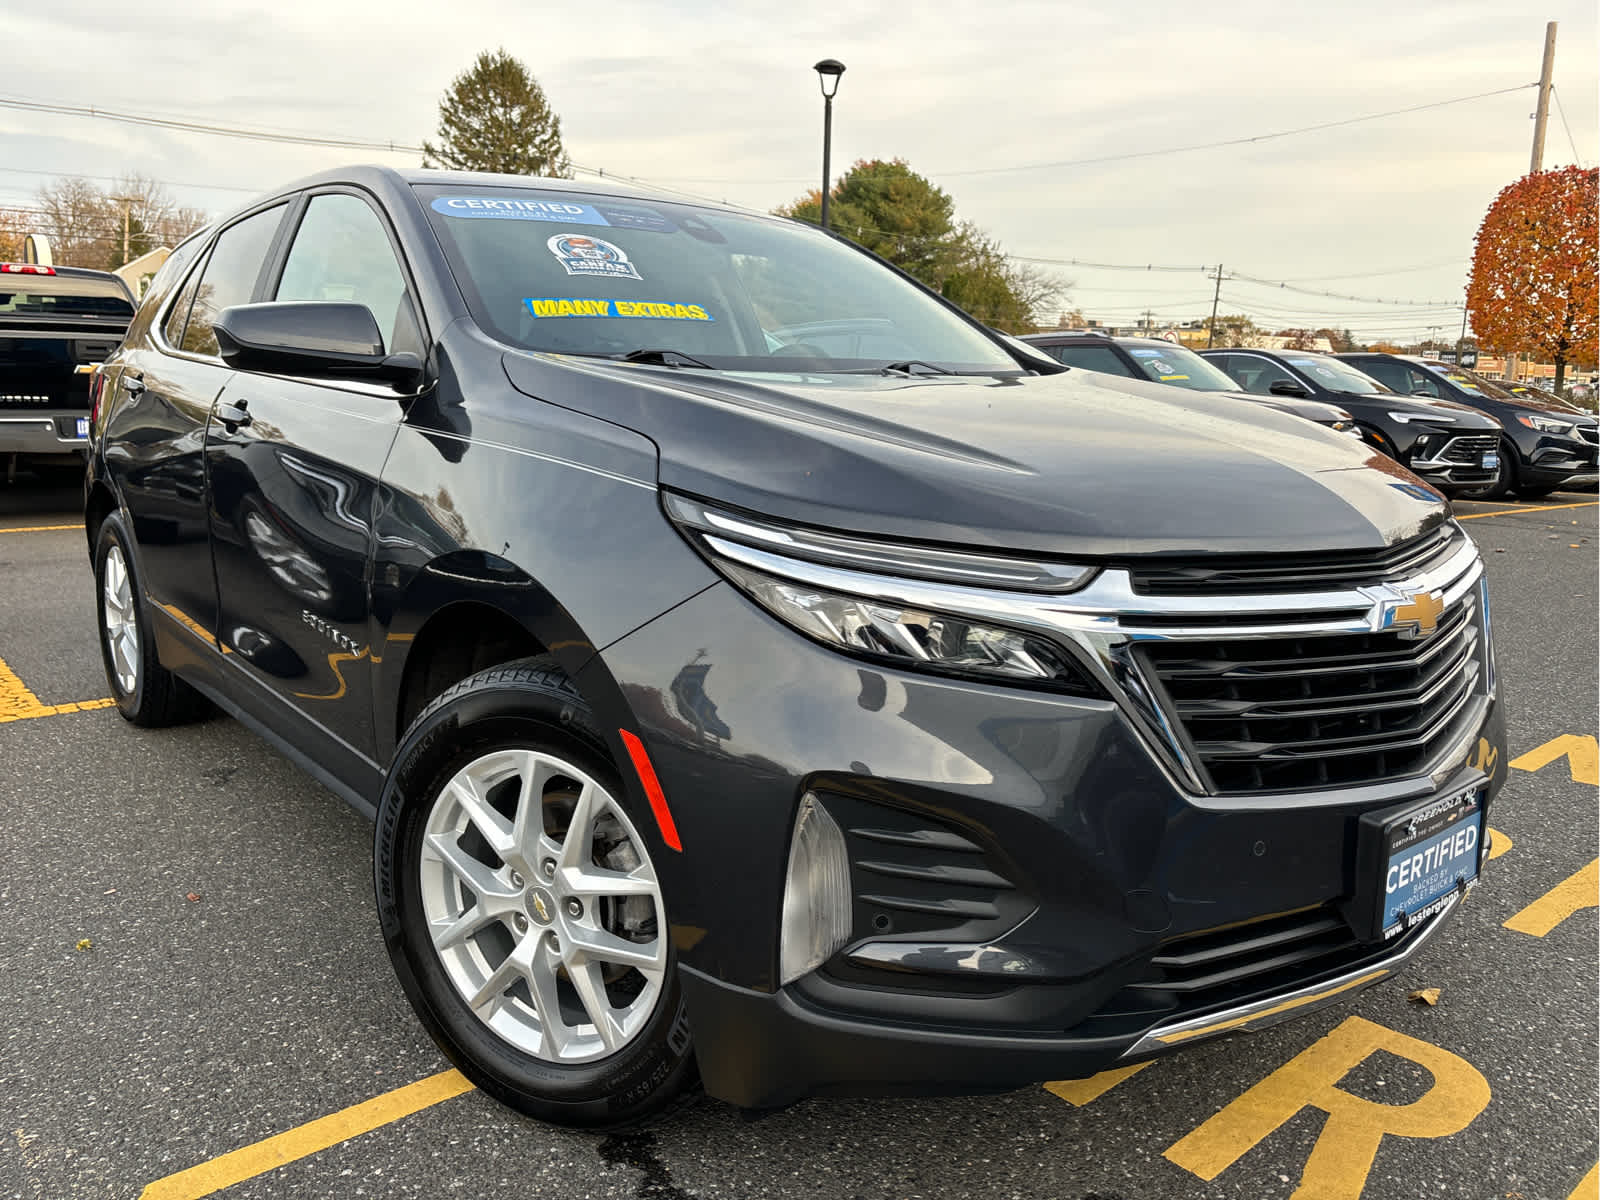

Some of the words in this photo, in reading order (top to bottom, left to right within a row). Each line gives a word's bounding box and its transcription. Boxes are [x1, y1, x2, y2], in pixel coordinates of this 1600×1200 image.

[447, 199, 584, 215] CERTIFIED
[532, 299, 609, 317] MANY
[614, 301, 709, 320] EXTRAS
[379, 791, 402, 897] MICHELIN
[1386, 825, 1477, 894] CERTIFIED
[1391, 887, 1428, 917] CHEVROLET
[1429, 878, 1449, 895] BUICK
[1413, 873, 1439, 894] BACKED
